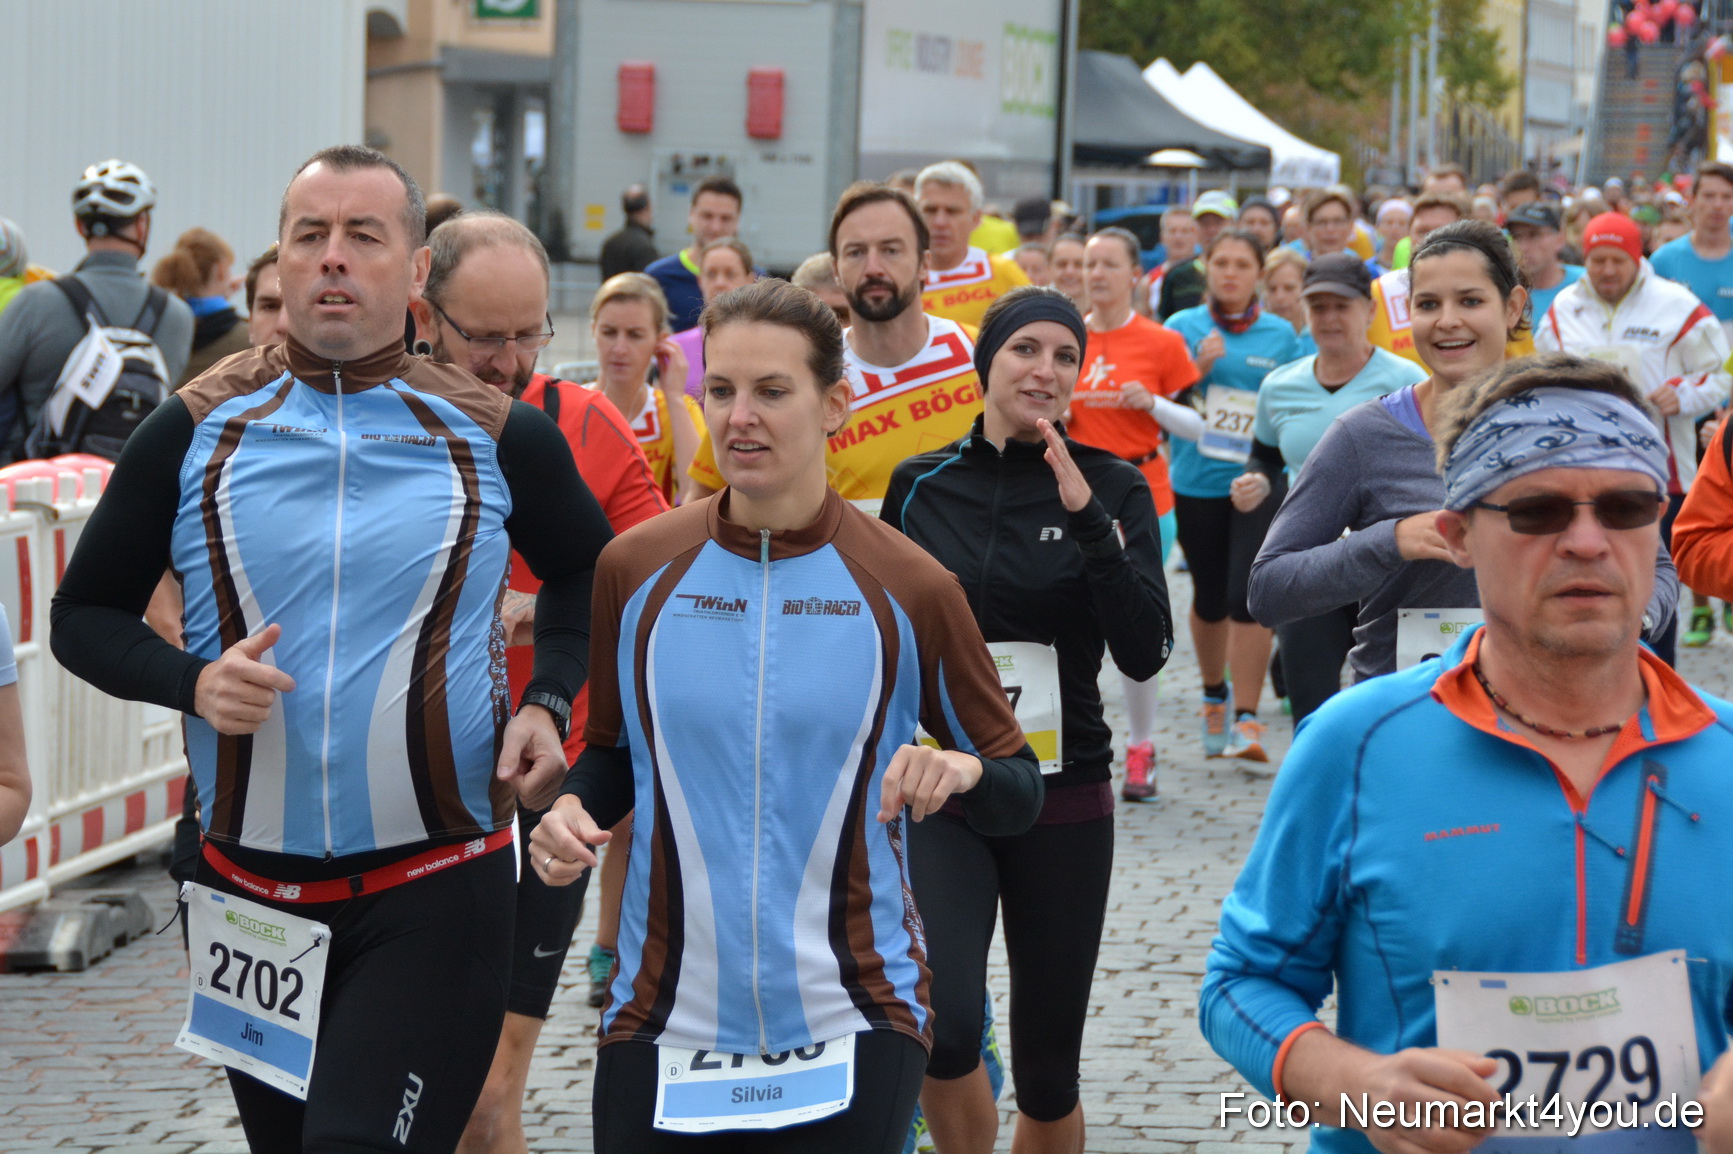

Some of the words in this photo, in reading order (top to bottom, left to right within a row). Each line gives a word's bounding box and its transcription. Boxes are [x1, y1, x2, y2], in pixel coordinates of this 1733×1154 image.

[827, 409, 902, 454] MAX
[1424, 823, 1500, 841] MAMMUT
[407, 865, 424, 878] new
[425, 853, 459, 872] balance
[231, 873, 244, 885] new
[244, 880, 269, 895] balance
[239, 914, 286, 941] BOCK
[209, 941, 304, 1021] 2702
[1534, 987, 1621, 1016] BOCK
[240, 1021, 264, 1046] Jim
[670, 1066, 678, 1076] D
[1484, 1034, 1662, 1120] 2729
[731, 1084, 783, 1104] Silvia
[392, 1071, 424, 1146] 2XU
